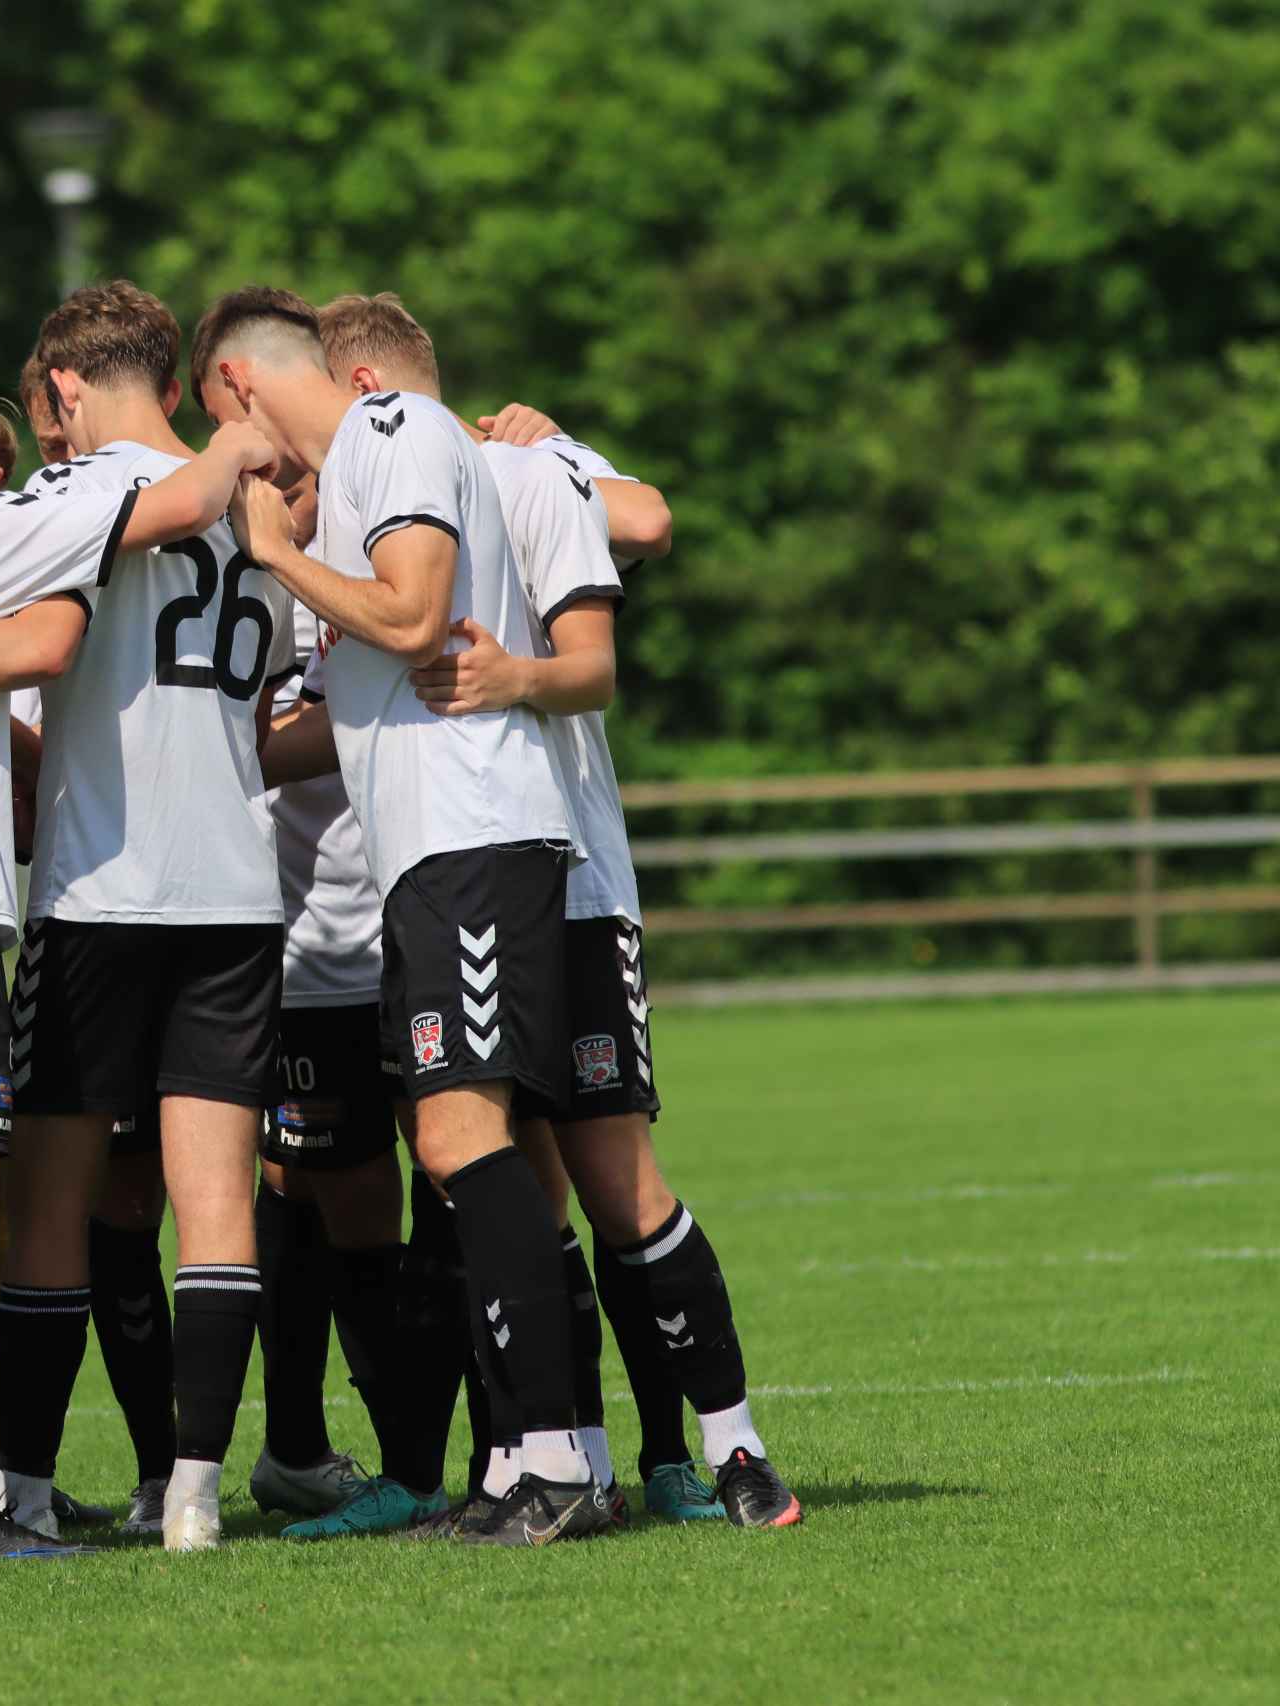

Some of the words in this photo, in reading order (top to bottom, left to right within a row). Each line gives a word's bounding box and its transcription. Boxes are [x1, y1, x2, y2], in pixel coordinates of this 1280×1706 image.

[155, 536, 274, 702] 26
[414, 1017, 438, 1030] VIF
[577, 1040, 610, 1050] VIF
[282, 1055, 316, 1091] 10
[280, 1128, 335, 1149] hummel
